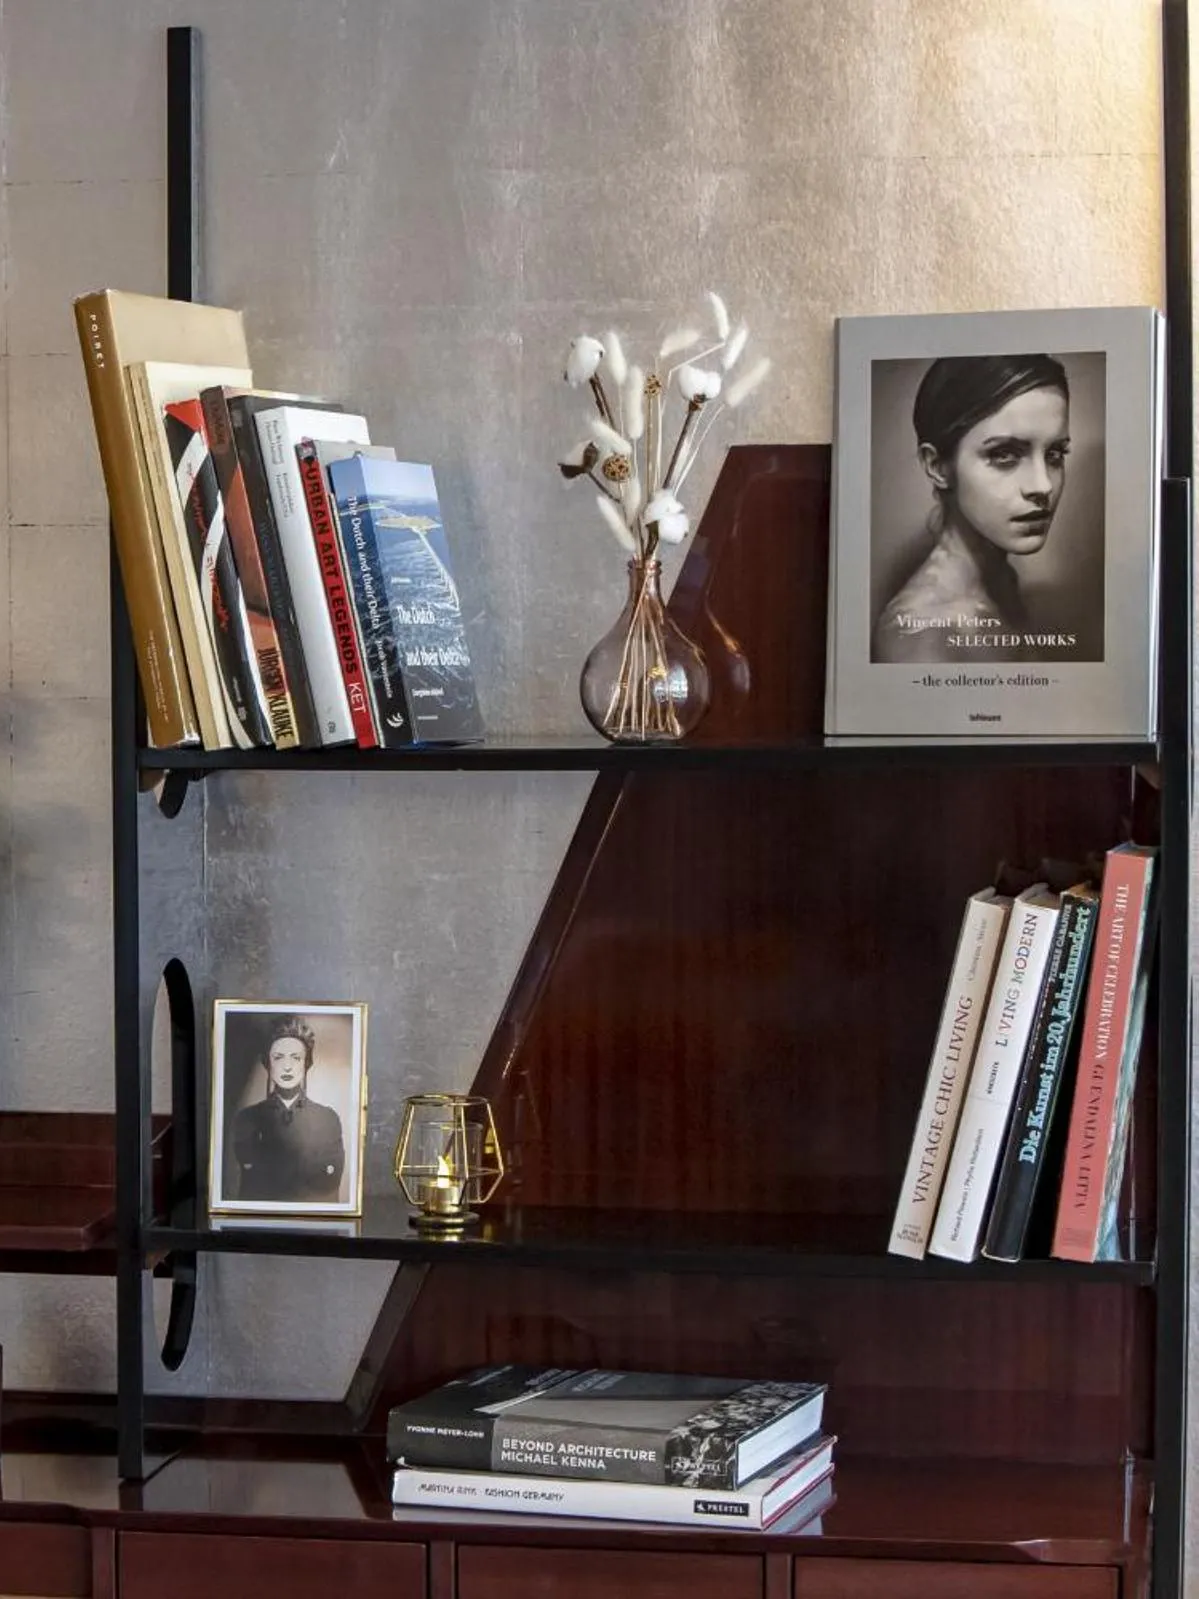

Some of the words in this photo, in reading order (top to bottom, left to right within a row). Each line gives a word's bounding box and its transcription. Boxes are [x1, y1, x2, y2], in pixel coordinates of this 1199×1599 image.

[306, 467, 330, 535] URBAN
[352, 518, 366, 549] Dutch
[320, 542, 338, 578] ART
[358, 553, 371, 572] and
[362, 573, 376, 599] their
[413, 602, 435, 625] Dutch
[897, 614, 951, 627] Vincent
[957, 613, 1001, 628] Peters
[328, 585, 357, 674] LEGENDS
[948, 634, 1020, 647] SELECTED
[1024, 634, 1076, 646] WORKS
[922, 675, 940, 687] the
[945, 674, 1004, 687] collector's
[1007, 674, 1049, 686] edition
[349, 682, 366, 713] KET
[268, 693, 295, 738] KLAUKE
[1115, 884, 1129, 911] THE
[1111, 916, 1125, 942] ART
[1052, 905, 1091, 1023] Jahrhundert
[1108, 943, 1122, 963] OF
[995, 988, 1020, 1046] LVING
[1012, 912, 1039, 985] MODERN
[1096, 964, 1118, 1059] CELEBRATION
[1040, 1045, 1060, 1073] im
[912, 1119, 945, 1203] VINTAGE
[935, 1066, 957, 1115] CHIC
[946, 994, 973, 1061] LIVING
[1026, 1072, 1054, 1129] Kunst
[1018, 1129, 1042, 1164] Die
[501, 1451, 557, 1467] MICHAEL
[561, 1456, 606, 1470] KENNA
[502, 1438, 554, 1453] BEYOND
[558, 1442, 656, 1462] ARCHITECTURE
